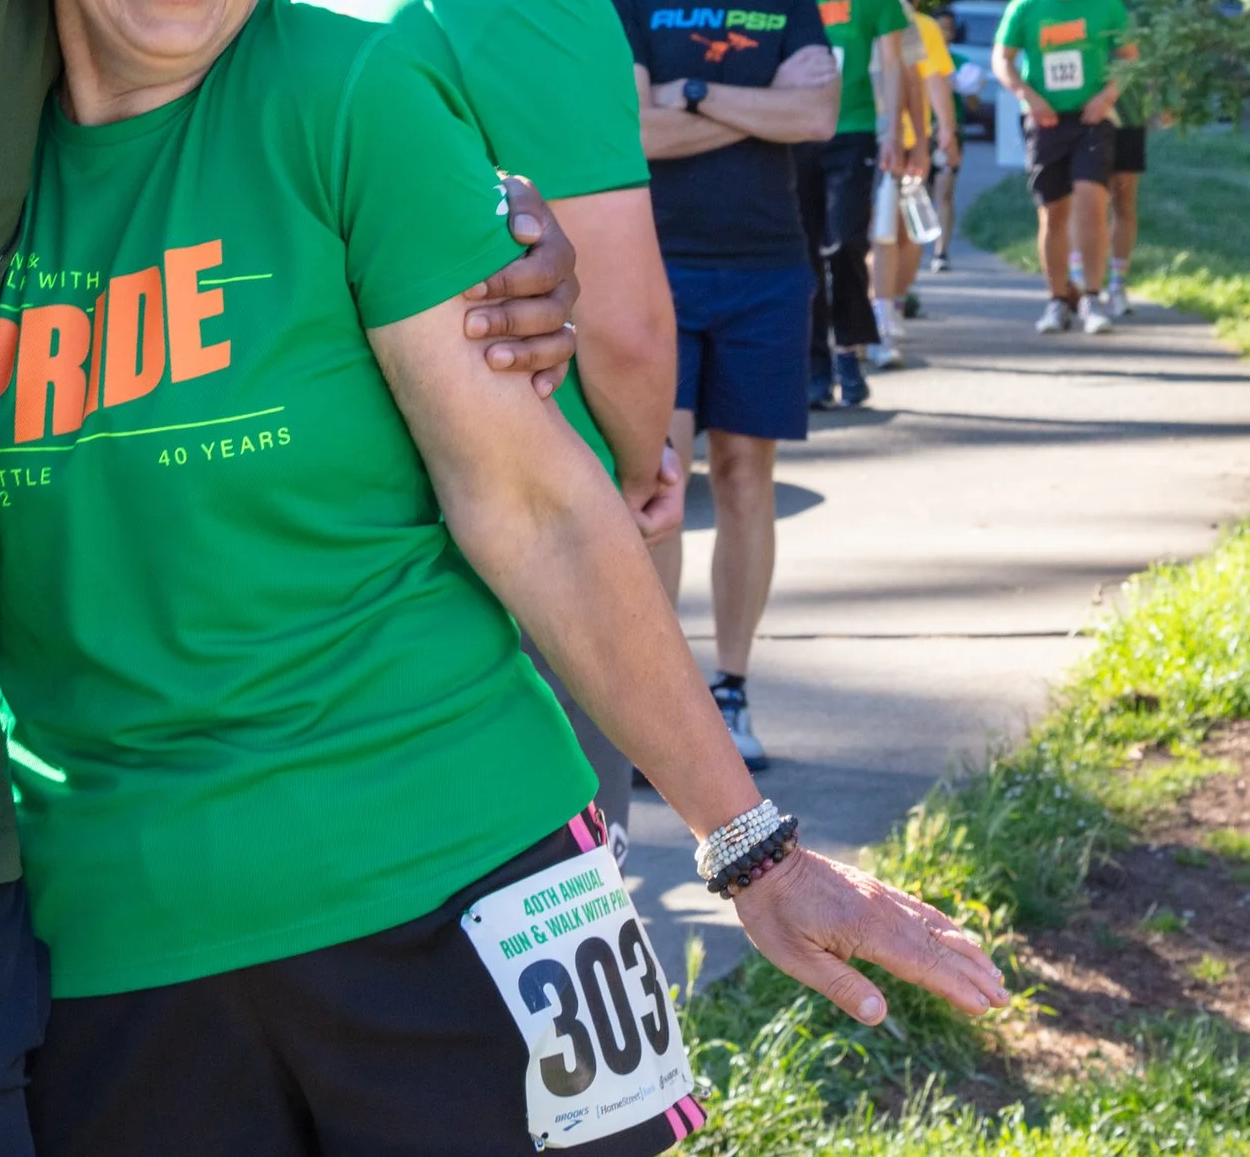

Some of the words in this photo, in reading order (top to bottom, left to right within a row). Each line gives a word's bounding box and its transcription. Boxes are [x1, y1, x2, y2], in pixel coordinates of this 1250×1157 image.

[39, 270, 99, 290] WITH
[158, 446, 187, 467] 40
[200, 427, 291, 461] YEARS
[523, 885, 560, 917] 40TH
[562, 868, 604, 903] ANNUAL
[499, 932, 531, 959] RUN
[533, 925, 548, 945] &
[545, 909, 584, 937] WALK
[581, 895, 611, 923] WITH
[518, 918, 669, 1097] 303
[555, 1107, 589, 1123] BROOKS
